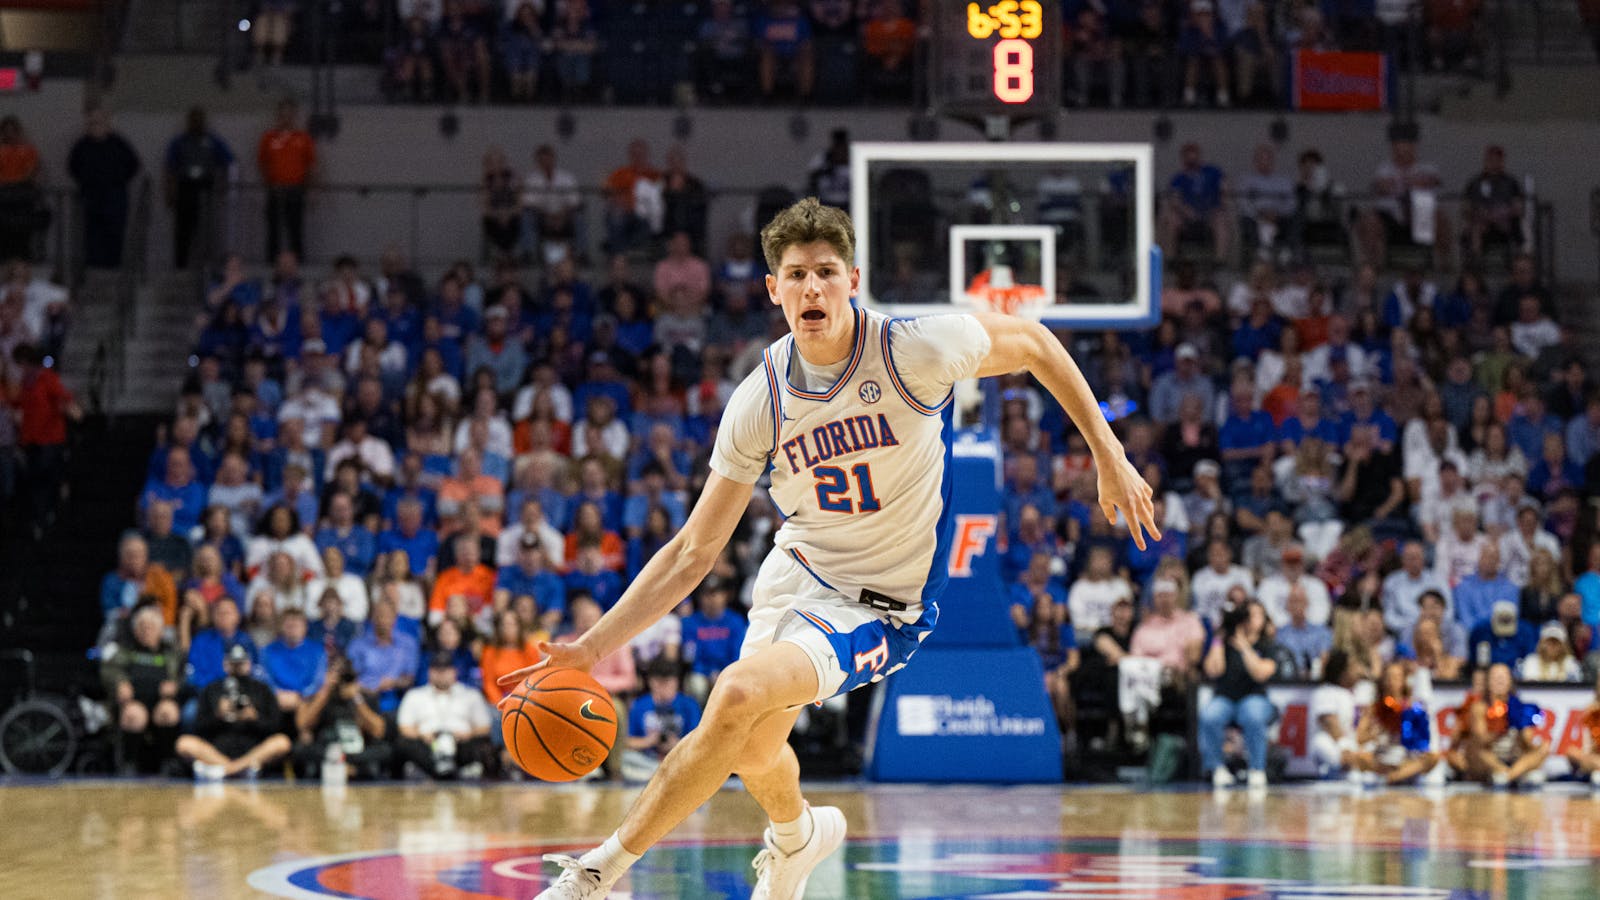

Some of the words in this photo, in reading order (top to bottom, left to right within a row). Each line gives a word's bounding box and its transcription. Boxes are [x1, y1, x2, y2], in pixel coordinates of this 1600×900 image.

[967, 0, 1043, 39] 6:53
[993, 38, 1034, 104] 8
[859, 382, 881, 403] SEC
[782, 413, 899, 475] FLORIDA
[812, 462, 882, 514] 21
[948, 514, 998, 578] F
